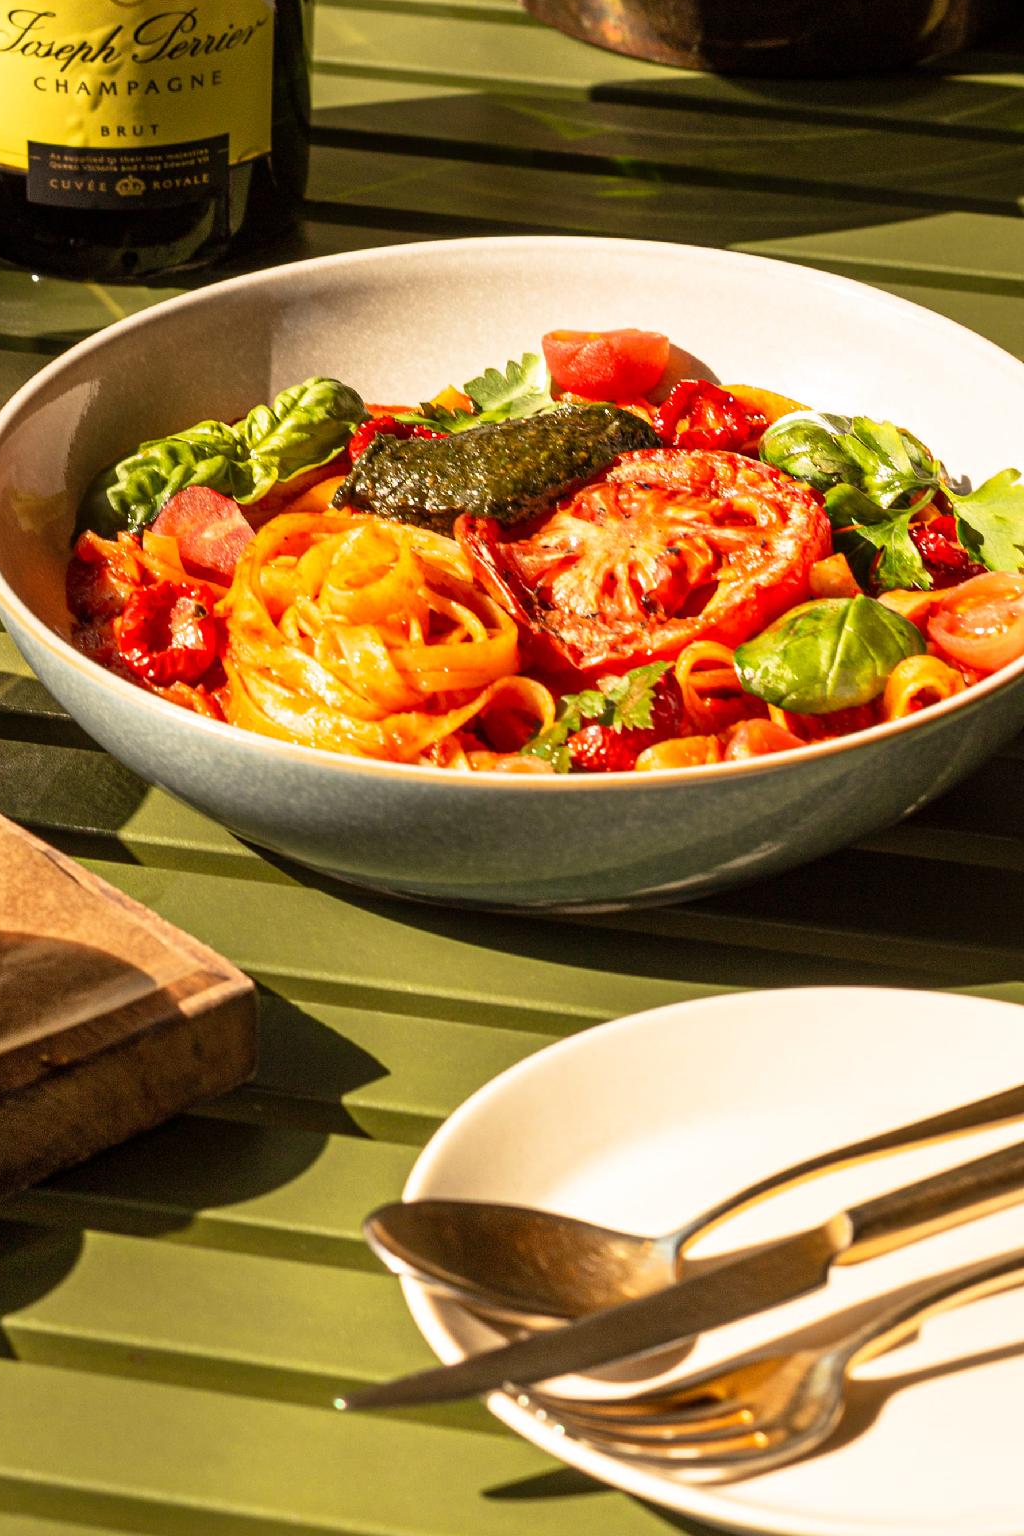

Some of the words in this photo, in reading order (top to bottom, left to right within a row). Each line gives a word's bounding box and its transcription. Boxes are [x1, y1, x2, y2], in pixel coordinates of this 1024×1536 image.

[131, 7, 268, 64] Perrier
[33, 70, 223, 96] CHAMPAGNE
[100, 124, 160, 138] BRUT
[153, 173, 210, 190] ROYALE
